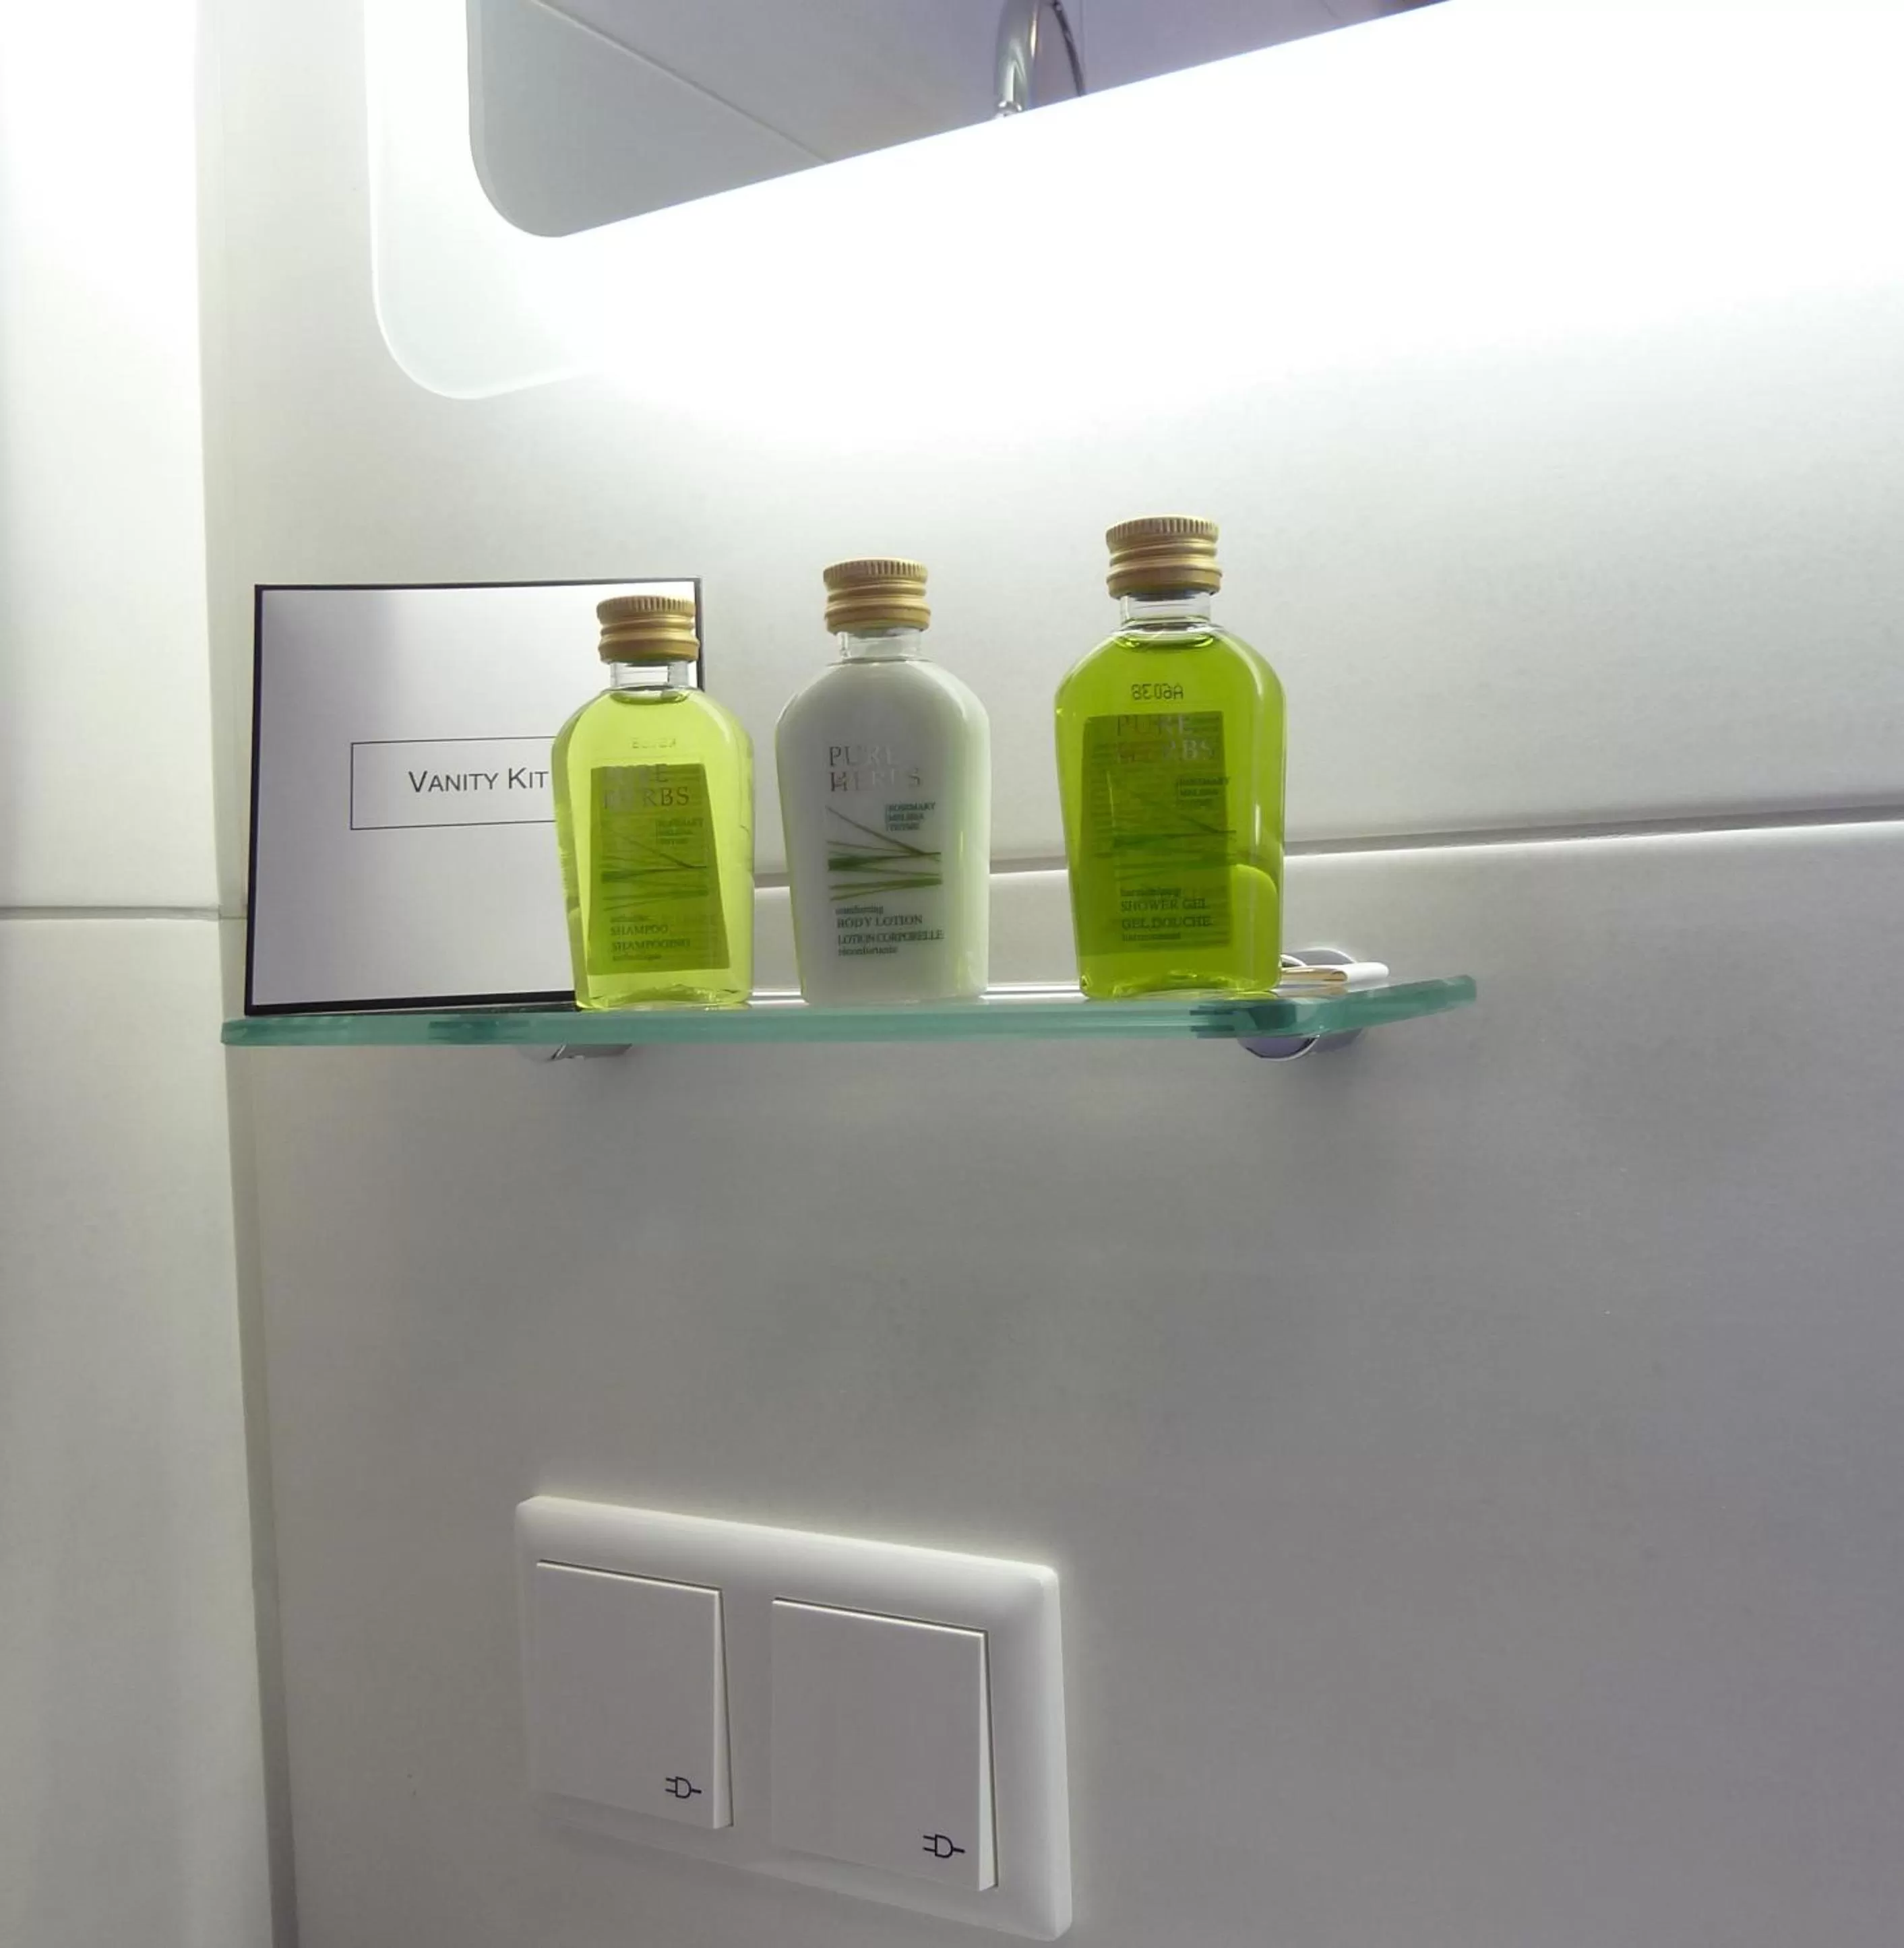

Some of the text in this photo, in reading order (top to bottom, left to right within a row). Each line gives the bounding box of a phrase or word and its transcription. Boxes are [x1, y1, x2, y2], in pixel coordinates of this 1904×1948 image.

[603, 764, 670, 784] RE
[603, 786, 689, 808] HRBS
[1121, 897, 1211, 911] SHOWER GEL
[837, 914, 923, 929] BODY LOTION
[1122, 915, 1214, 930] GEL DOUCHE
[610, 924, 669, 936] SHAMPOO
[838, 934, 875, 946] LOTION
